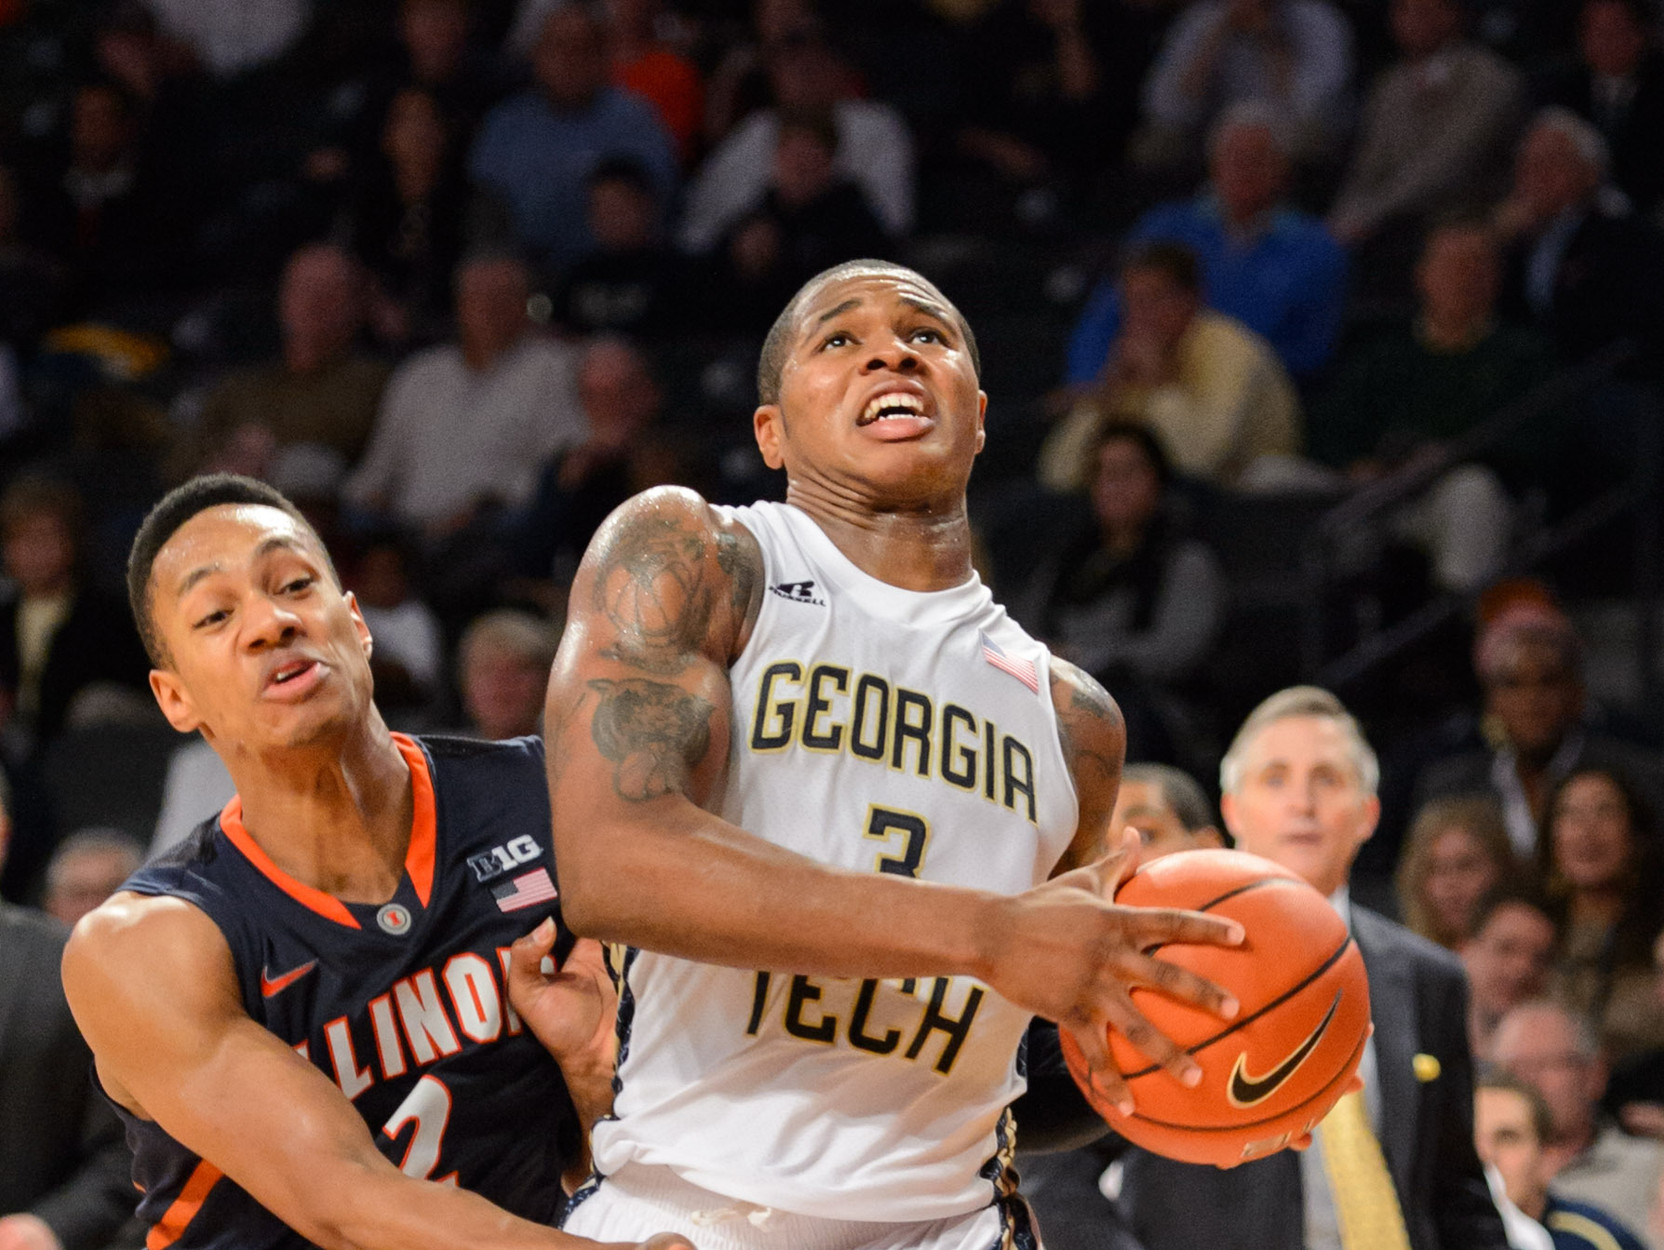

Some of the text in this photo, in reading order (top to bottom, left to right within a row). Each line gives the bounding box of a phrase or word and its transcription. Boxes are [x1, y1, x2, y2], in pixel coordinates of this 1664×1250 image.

[749, 659, 1039, 828] GEORGIA
[862, 803, 932, 878] 3
[293, 946, 557, 1101] LINOI
[382, 1073, 459, 1187] 2
